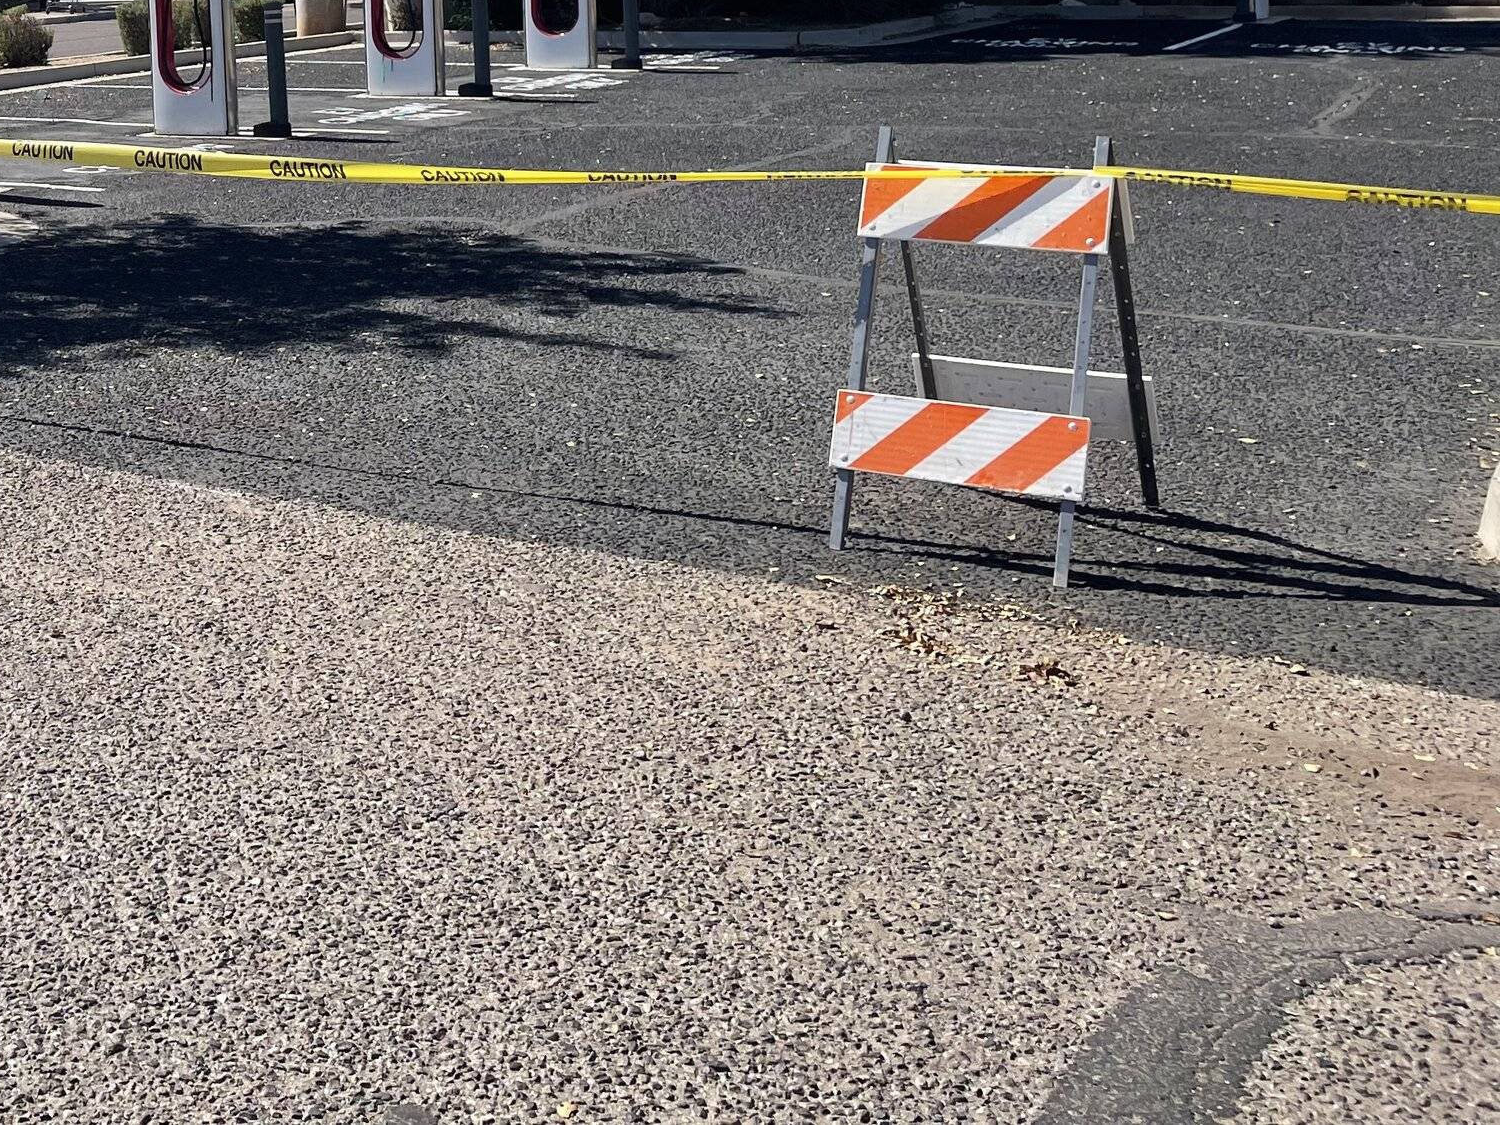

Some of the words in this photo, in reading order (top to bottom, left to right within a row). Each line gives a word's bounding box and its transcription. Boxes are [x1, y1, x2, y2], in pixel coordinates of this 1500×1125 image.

[12, 142, 74, 161] CAUTION
[134, 150, 203, 172] CAUTION
[269, 160, 347, 180] CAUTION
[421, 169, 505, 183] CAUTION
